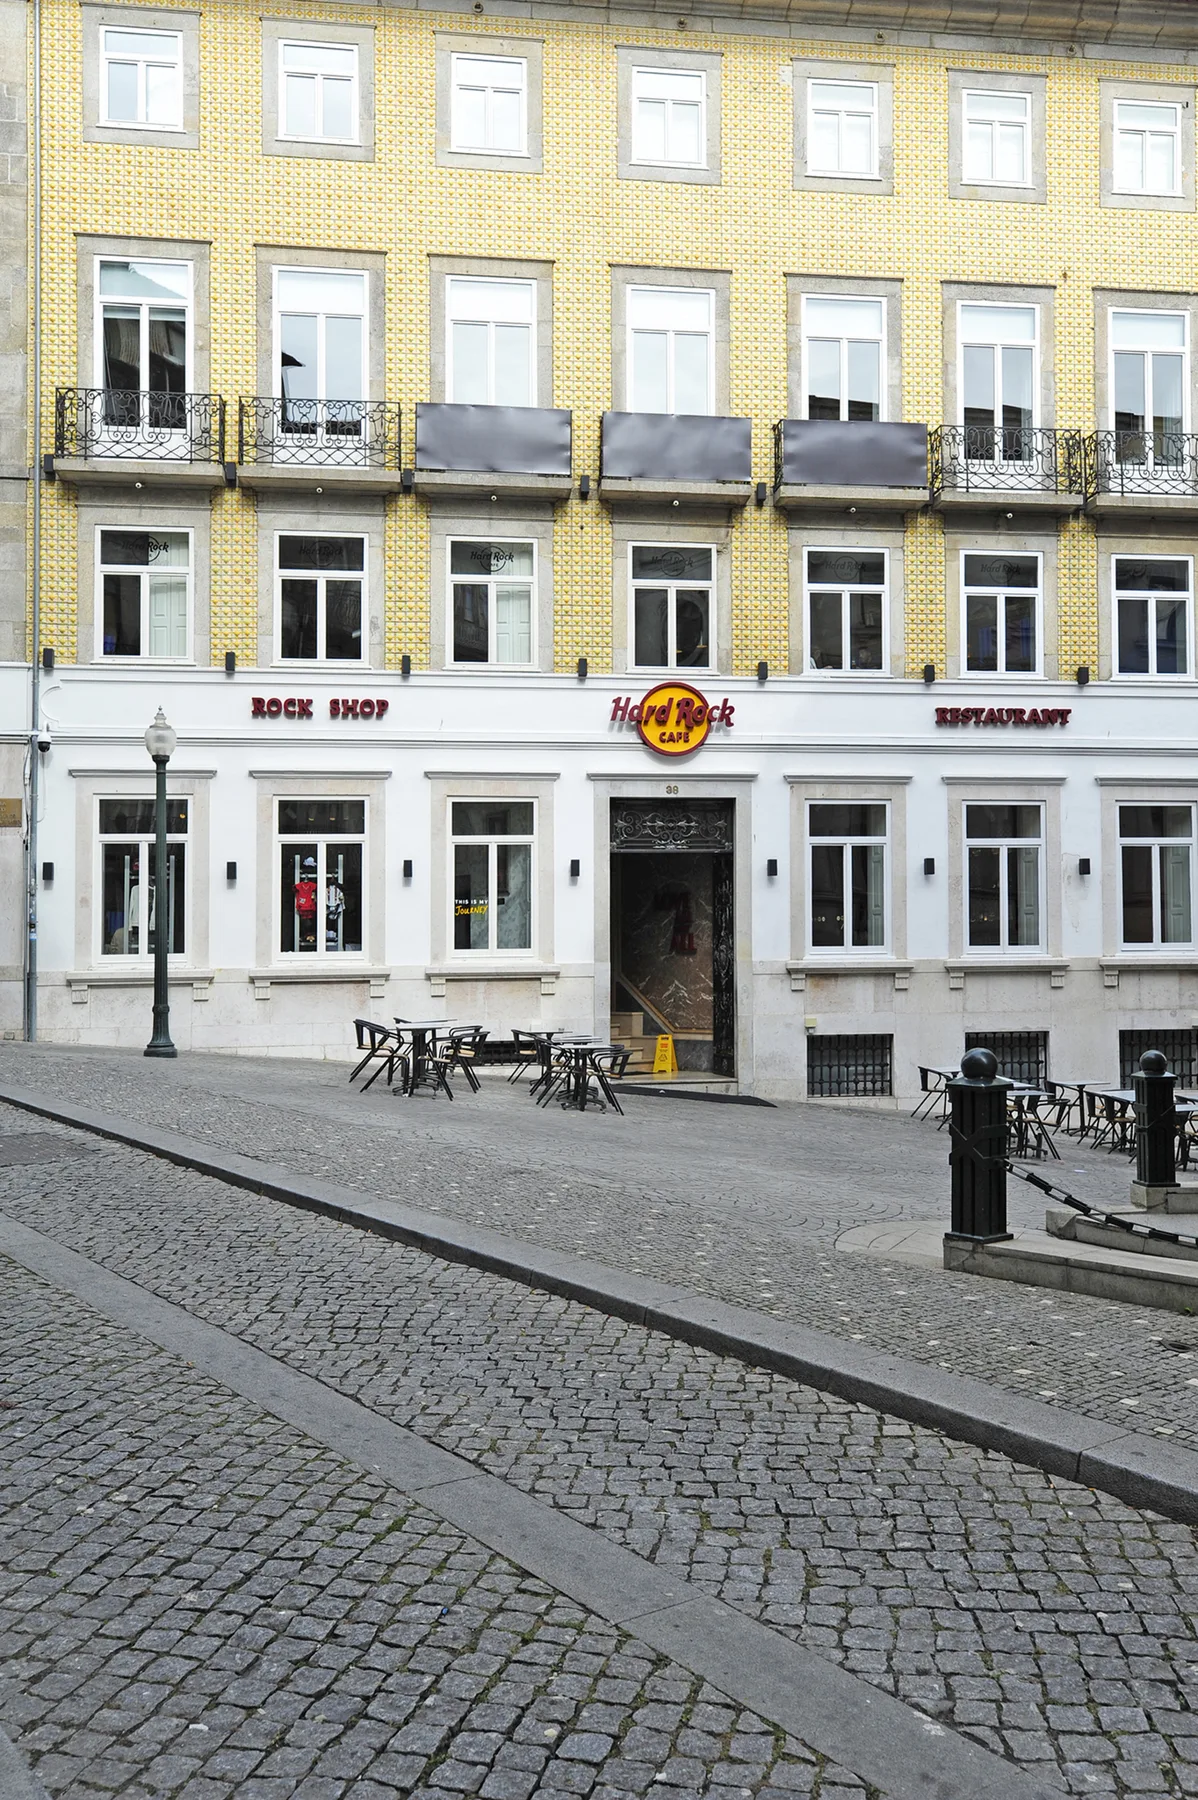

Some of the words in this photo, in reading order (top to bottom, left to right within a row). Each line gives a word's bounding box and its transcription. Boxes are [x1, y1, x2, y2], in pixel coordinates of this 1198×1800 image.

[147, 541, 169, 553] Rock
[470, 551, 493, 560] Hard
[493, 551, 515, 562] Rock
[825, 560, 846, 570] Hard
[980, 563, 1001, 573] Hard
[251, 697, 313, 717] ROCK
[329, 698, 389, 717] SHOP
[610, 696, 675, 725] Hard
[676, 697, 736, 728] Rock
[935, 707, 1072, 725] RESTAURANT
[659, 731, 690, 744] CAFE
[665, 785, 679, 795] 38
